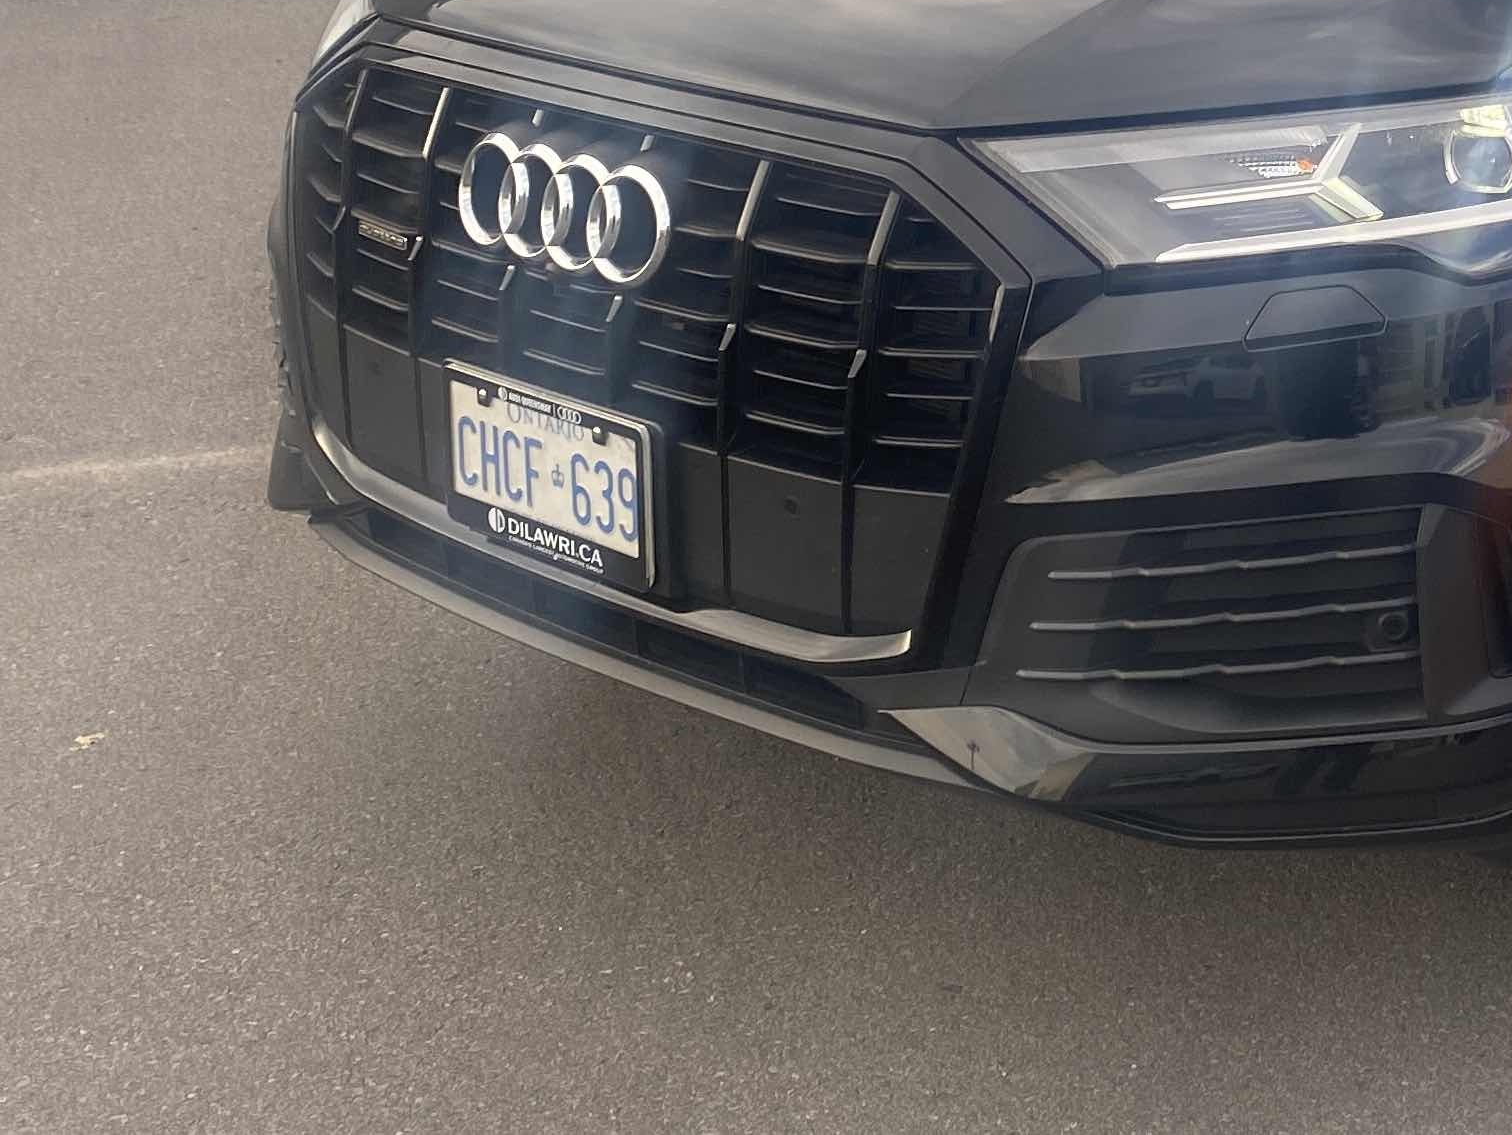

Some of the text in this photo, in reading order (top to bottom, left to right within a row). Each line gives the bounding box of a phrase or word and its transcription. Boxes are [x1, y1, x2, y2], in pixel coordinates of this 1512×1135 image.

[457, 415, 638, 542] CHCF 639
[507, 517, 604, 568] DILAWRI.CA
